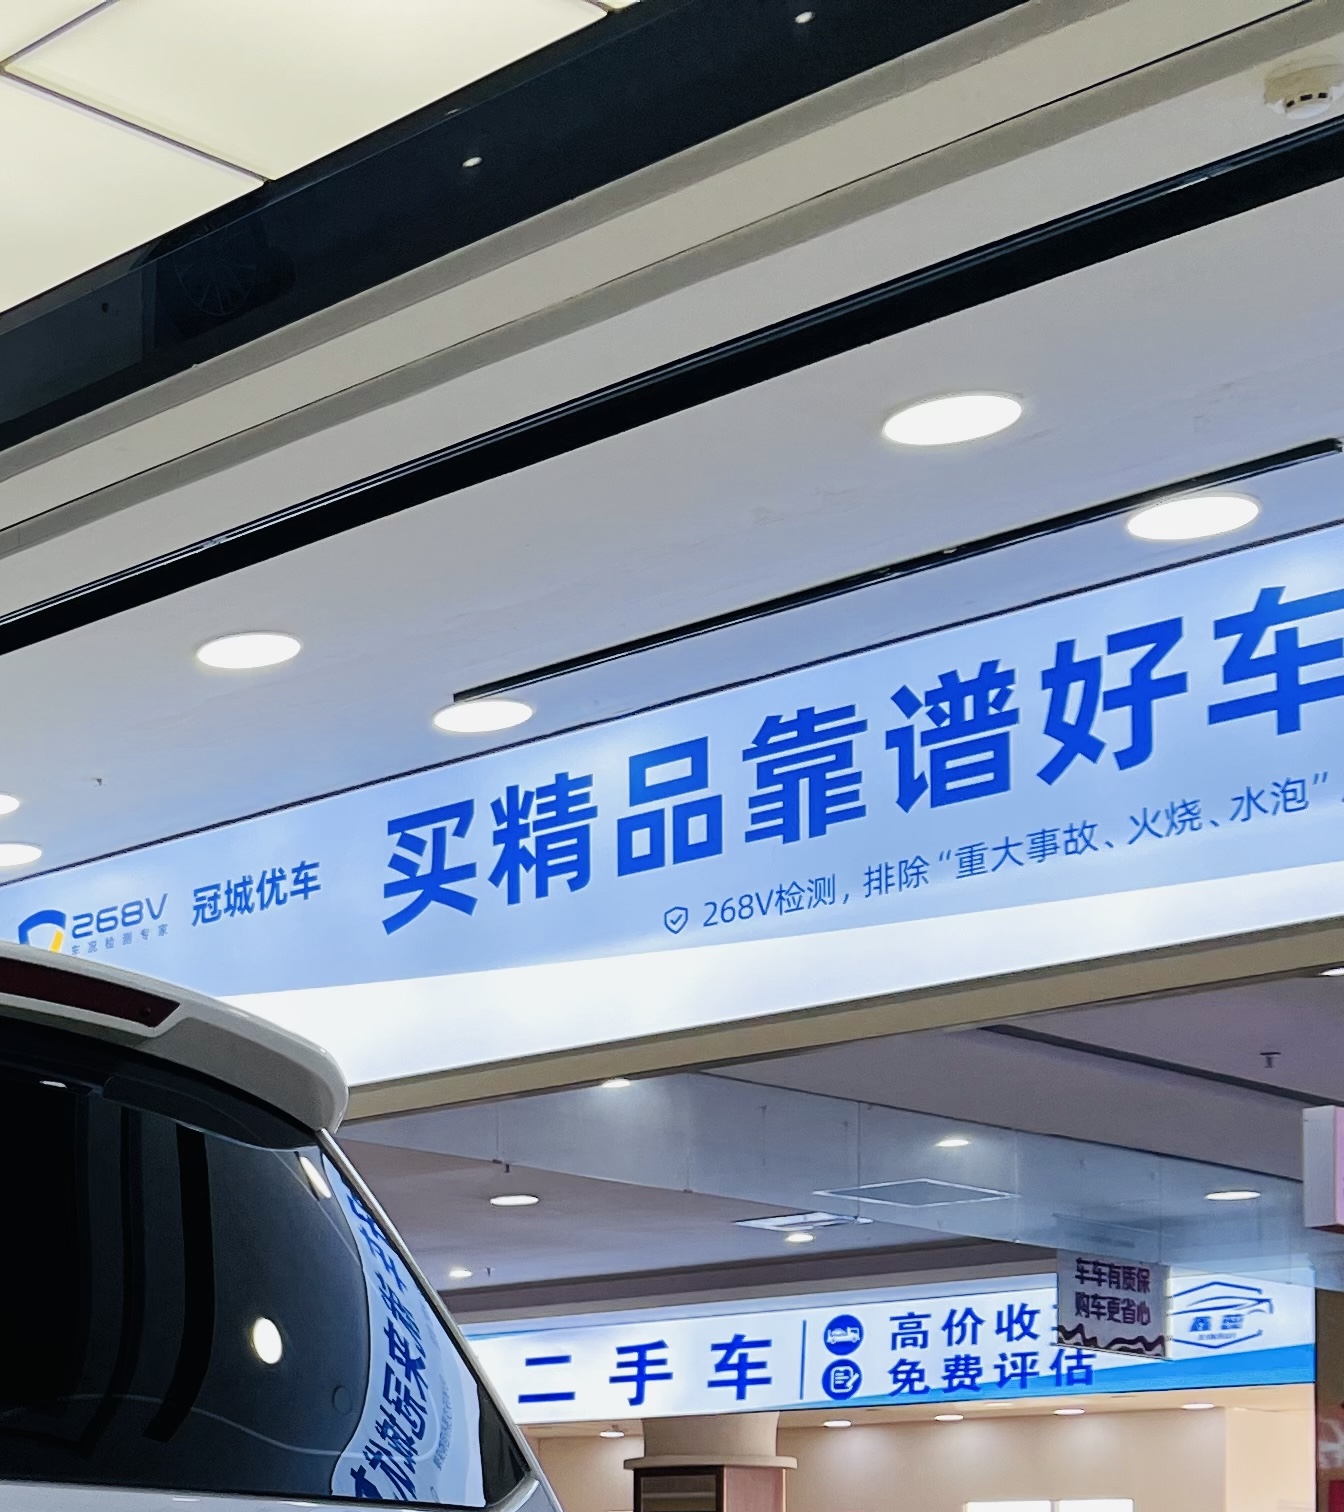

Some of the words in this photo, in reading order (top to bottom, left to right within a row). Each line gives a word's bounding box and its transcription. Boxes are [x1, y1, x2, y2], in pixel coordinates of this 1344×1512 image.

[382, 585, 1344, 935] 买精品靠谱好车
[72, 892, 169, 939] 268V
[192, 860, 322, 927] 冠城优车
[1075, 1257, 1151, 1294] 车车有质保
[889, 1302, 1059, 1351] 高价收
[1074, 1291, 1151, 1325] 购车更省心
[517, 1334, 774, 1407] 二手车
[887, 1347, 1096, 1397] 免费评估
